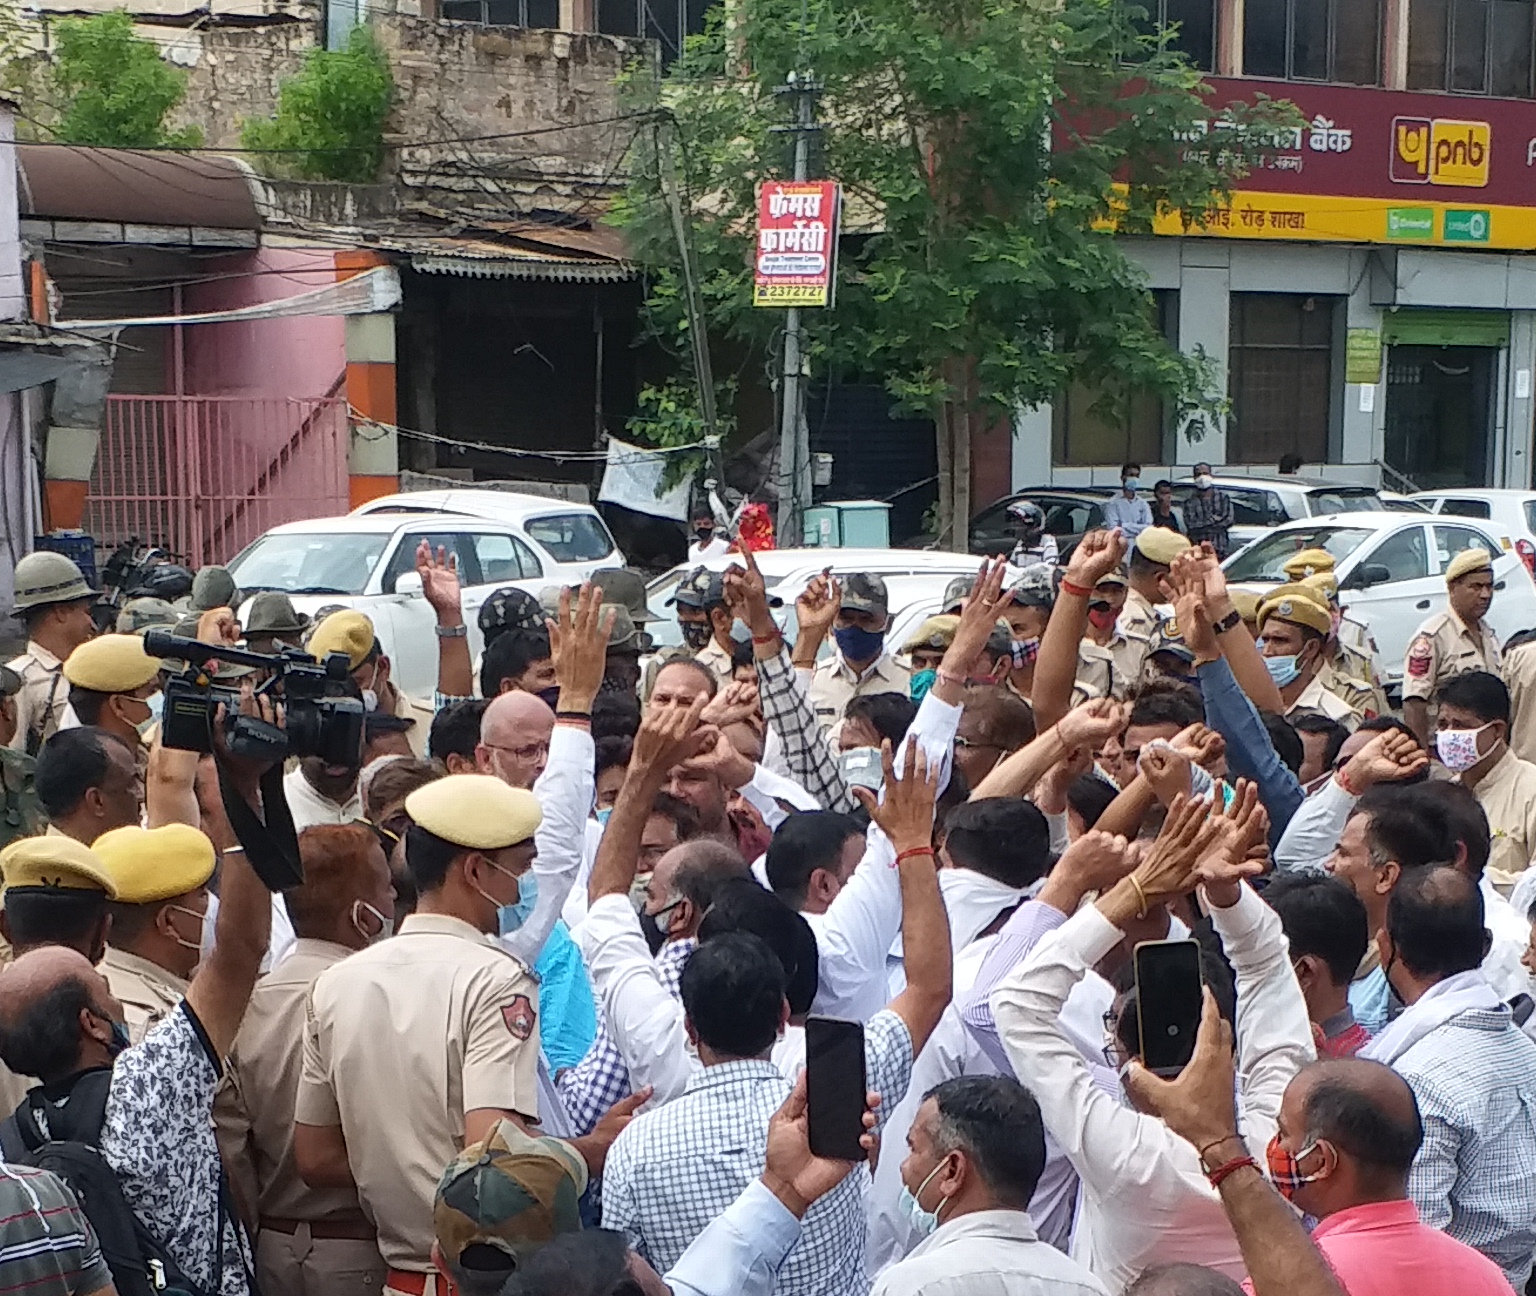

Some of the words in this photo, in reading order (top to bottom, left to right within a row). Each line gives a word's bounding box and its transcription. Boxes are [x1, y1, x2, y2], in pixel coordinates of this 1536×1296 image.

[1310, 115, 1352, 152] बैंक
[1435, 130, 1484, 176] pnb
[1269, 211, 1305, 230] शाखा
[769, 285, 824, 298] 2372727
